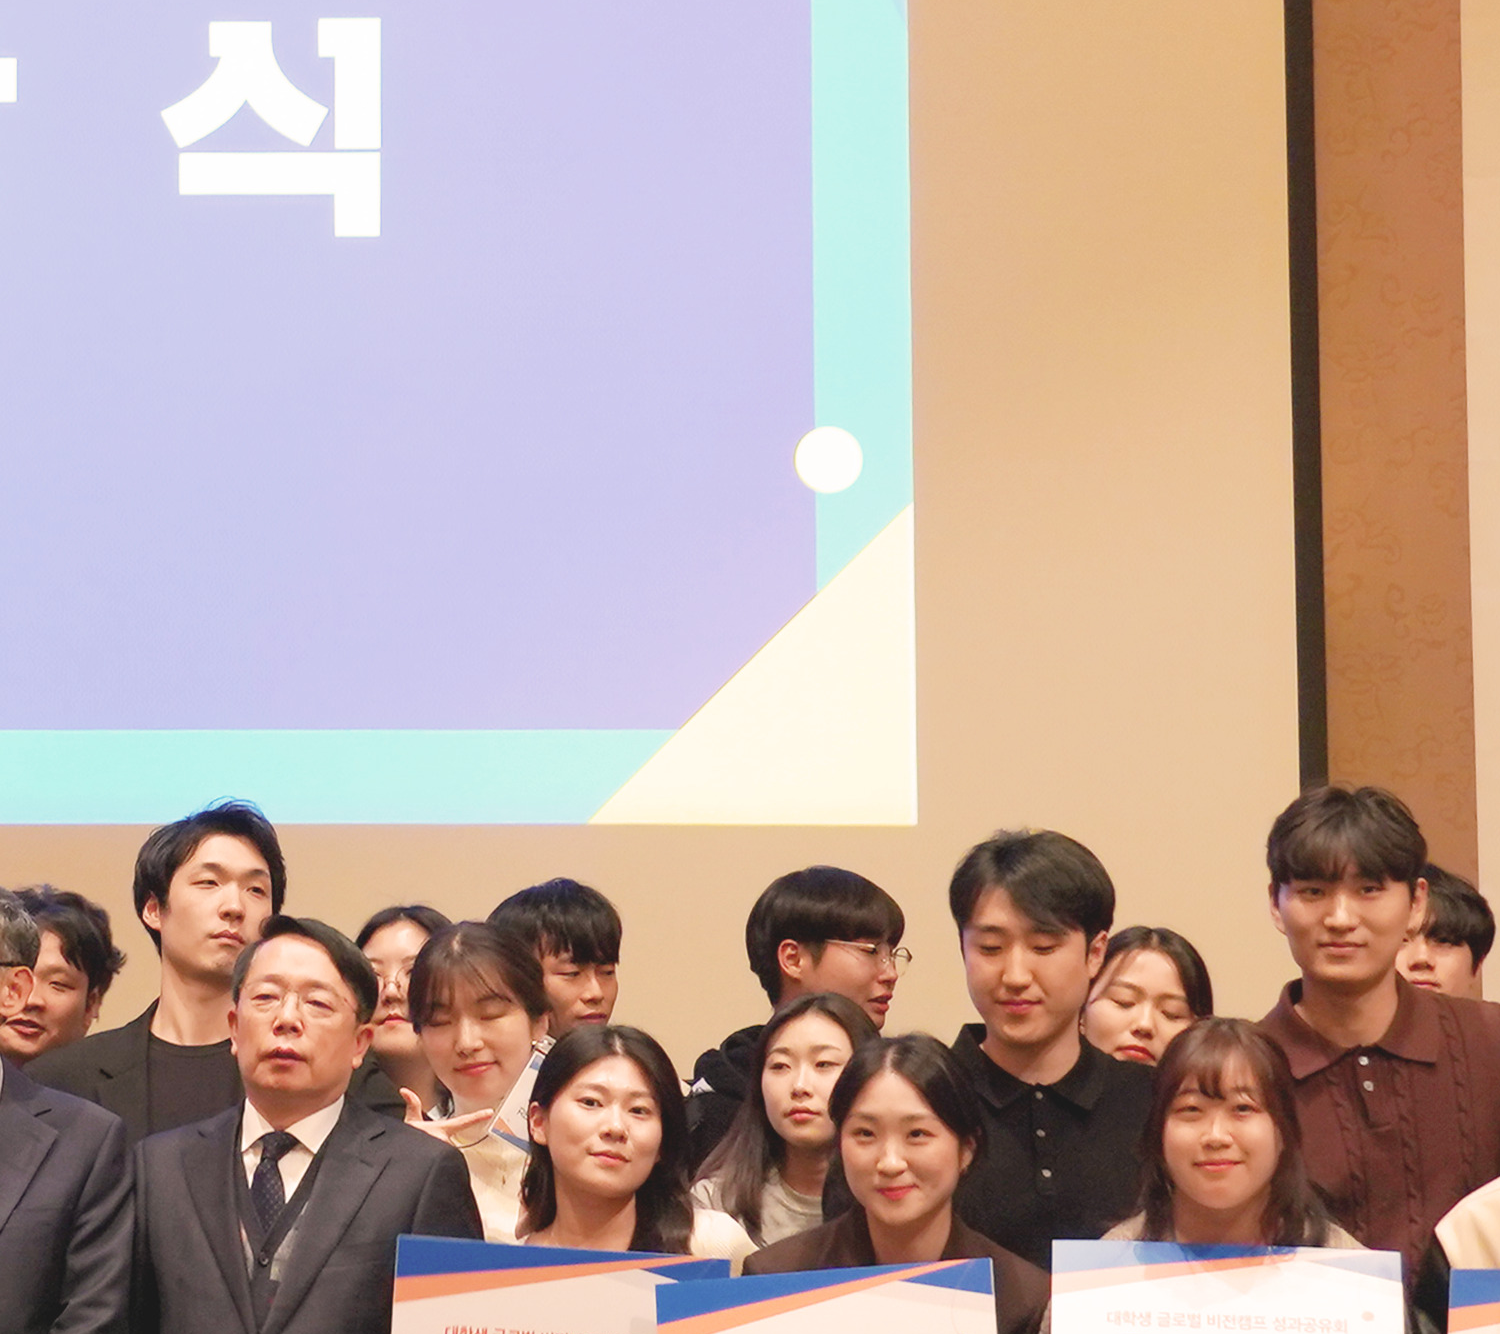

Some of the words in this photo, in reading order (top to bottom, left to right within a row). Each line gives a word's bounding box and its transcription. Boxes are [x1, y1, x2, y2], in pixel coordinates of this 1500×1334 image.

[1107, 1311, 1151, 1328] 대학생
[1158, 1313, 1201, 1329] 글로벌
[1207, 1314, 1267, 1331] 비전캠프
[1272, 1315, 1348, 1334] 성과공유회
